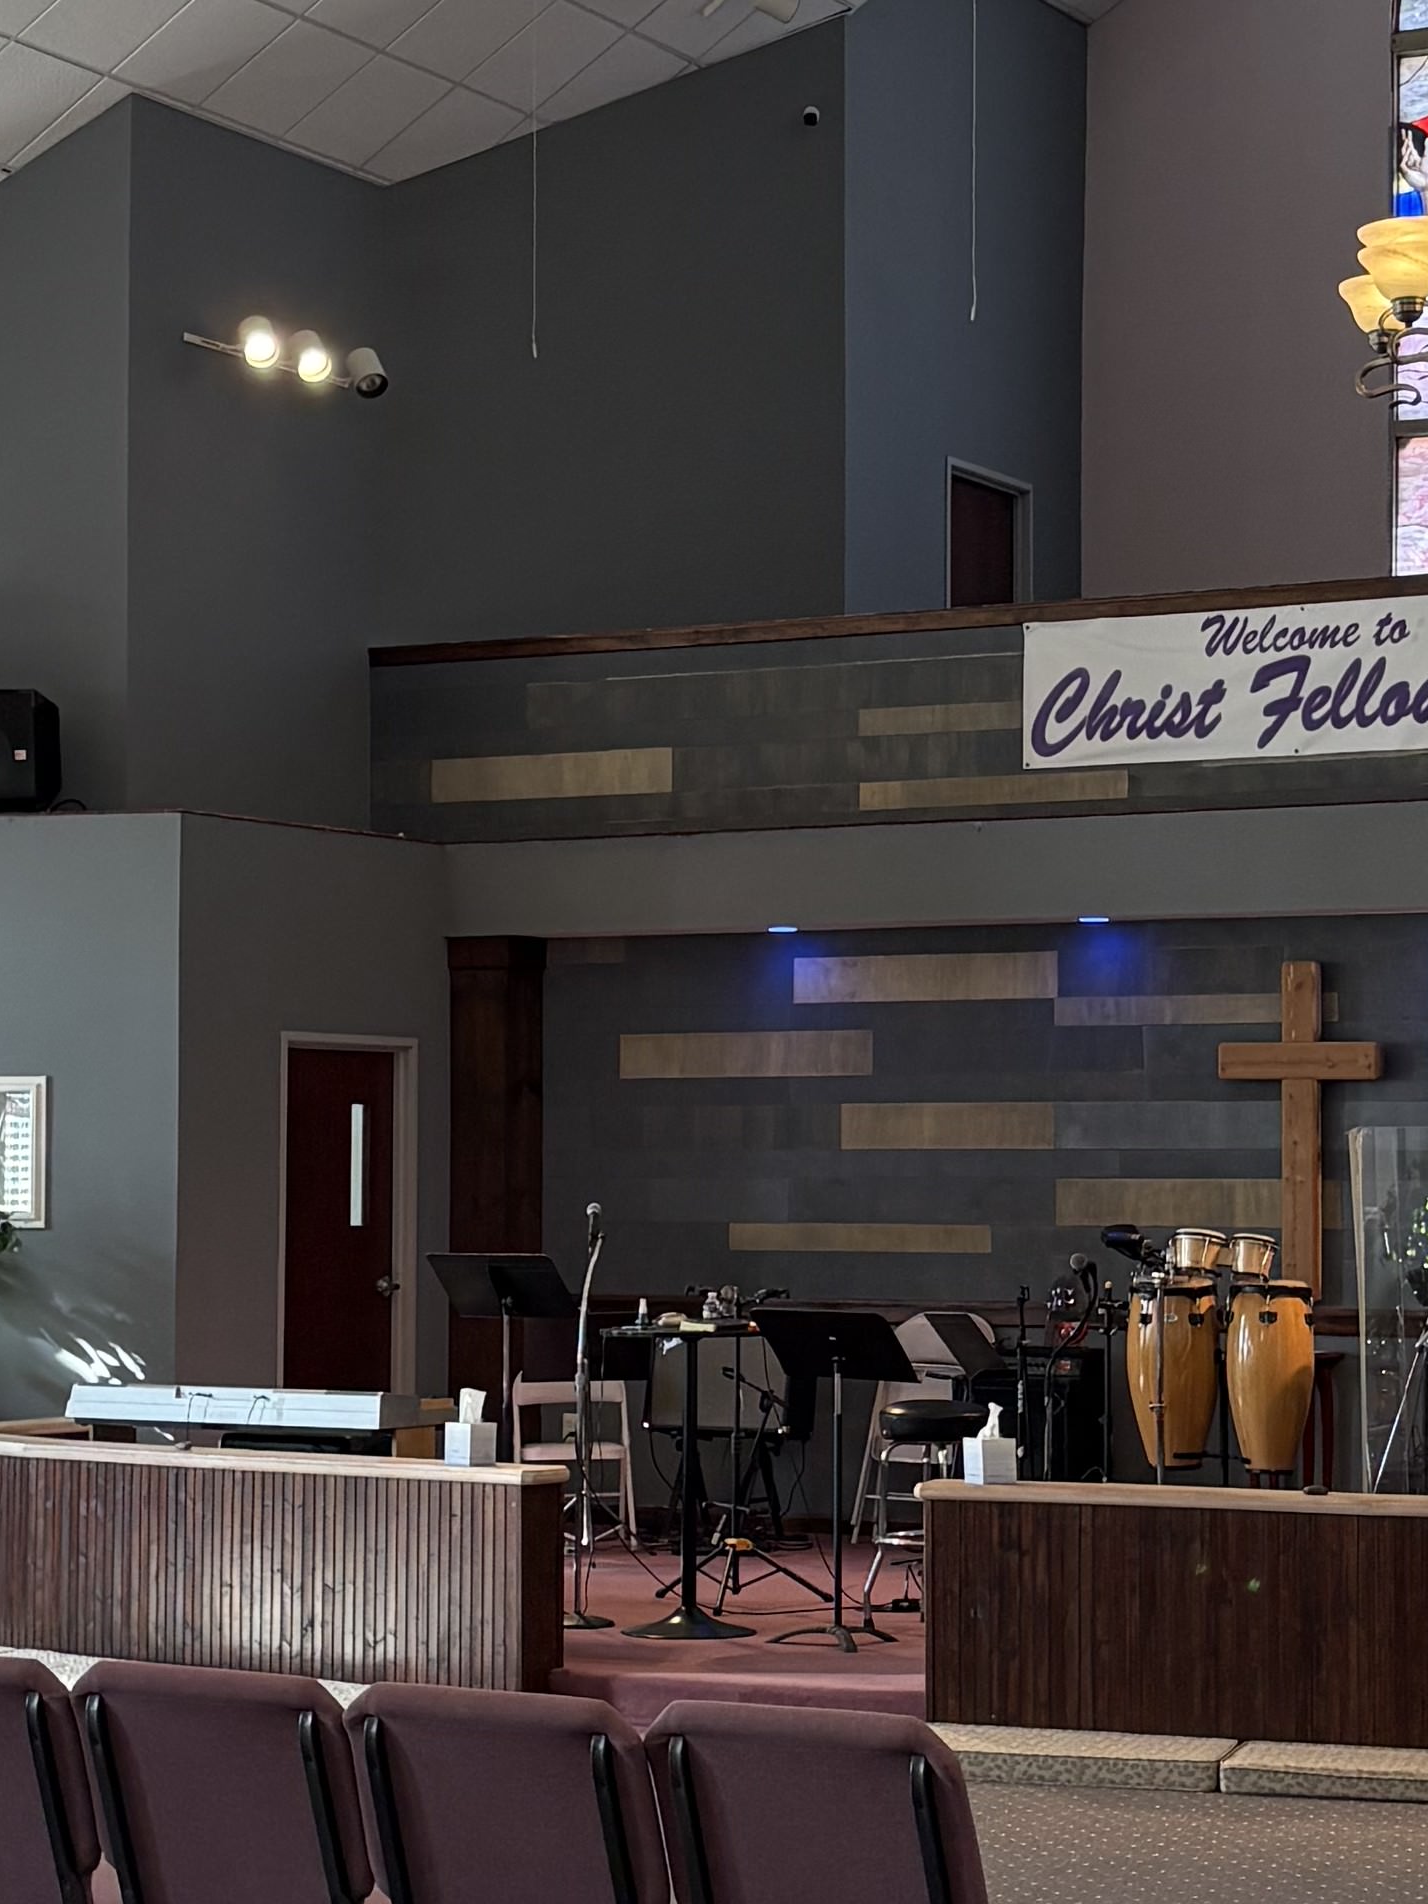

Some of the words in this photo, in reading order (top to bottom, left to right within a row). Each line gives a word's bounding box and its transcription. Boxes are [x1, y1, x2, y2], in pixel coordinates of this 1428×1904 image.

[1200, 613, 1361, 658] Welcome
[1372, 612, 1411, 647] to
[1030, 667, 1228, 758] Christ
